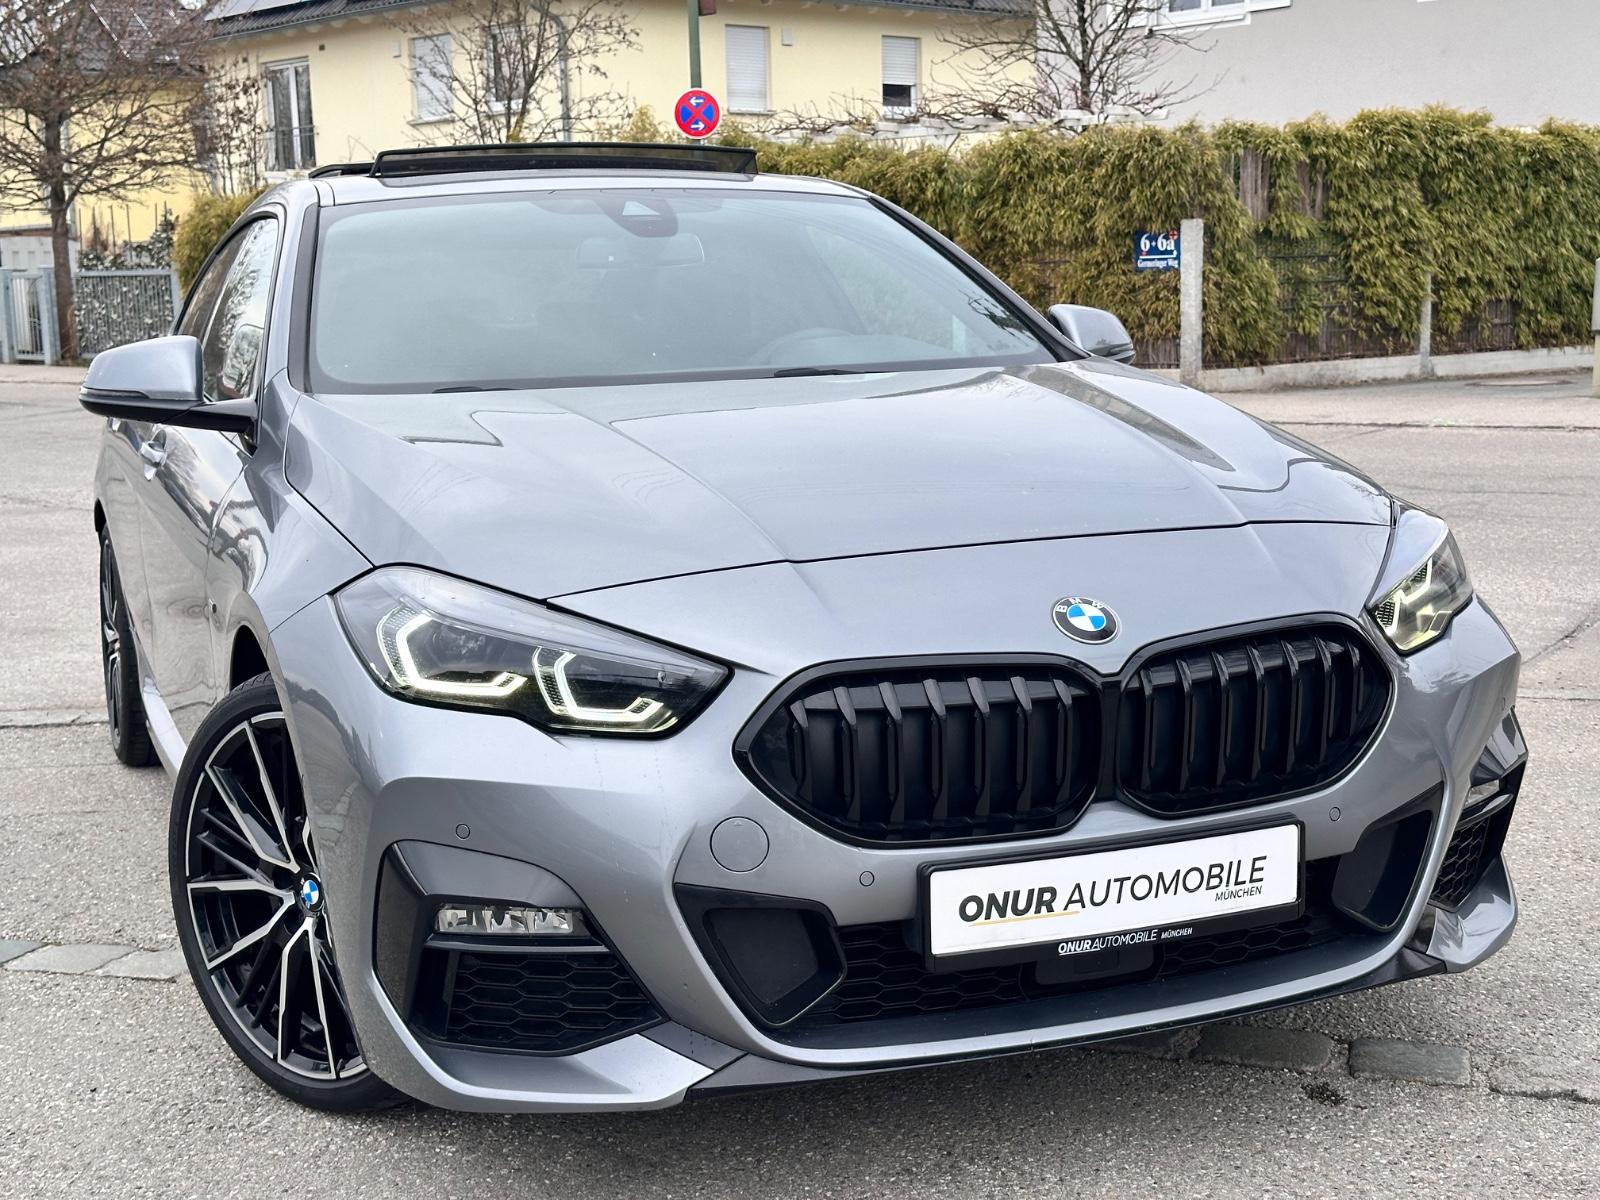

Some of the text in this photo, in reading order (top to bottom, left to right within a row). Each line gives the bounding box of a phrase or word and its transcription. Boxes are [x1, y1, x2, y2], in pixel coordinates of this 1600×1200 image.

[1055, 597, 1105, 613] BMW
[959, 855, 1267, 922] ONUR AUTOMOBILE
[1214, 885, 1263, 902] MÜNCHEN
